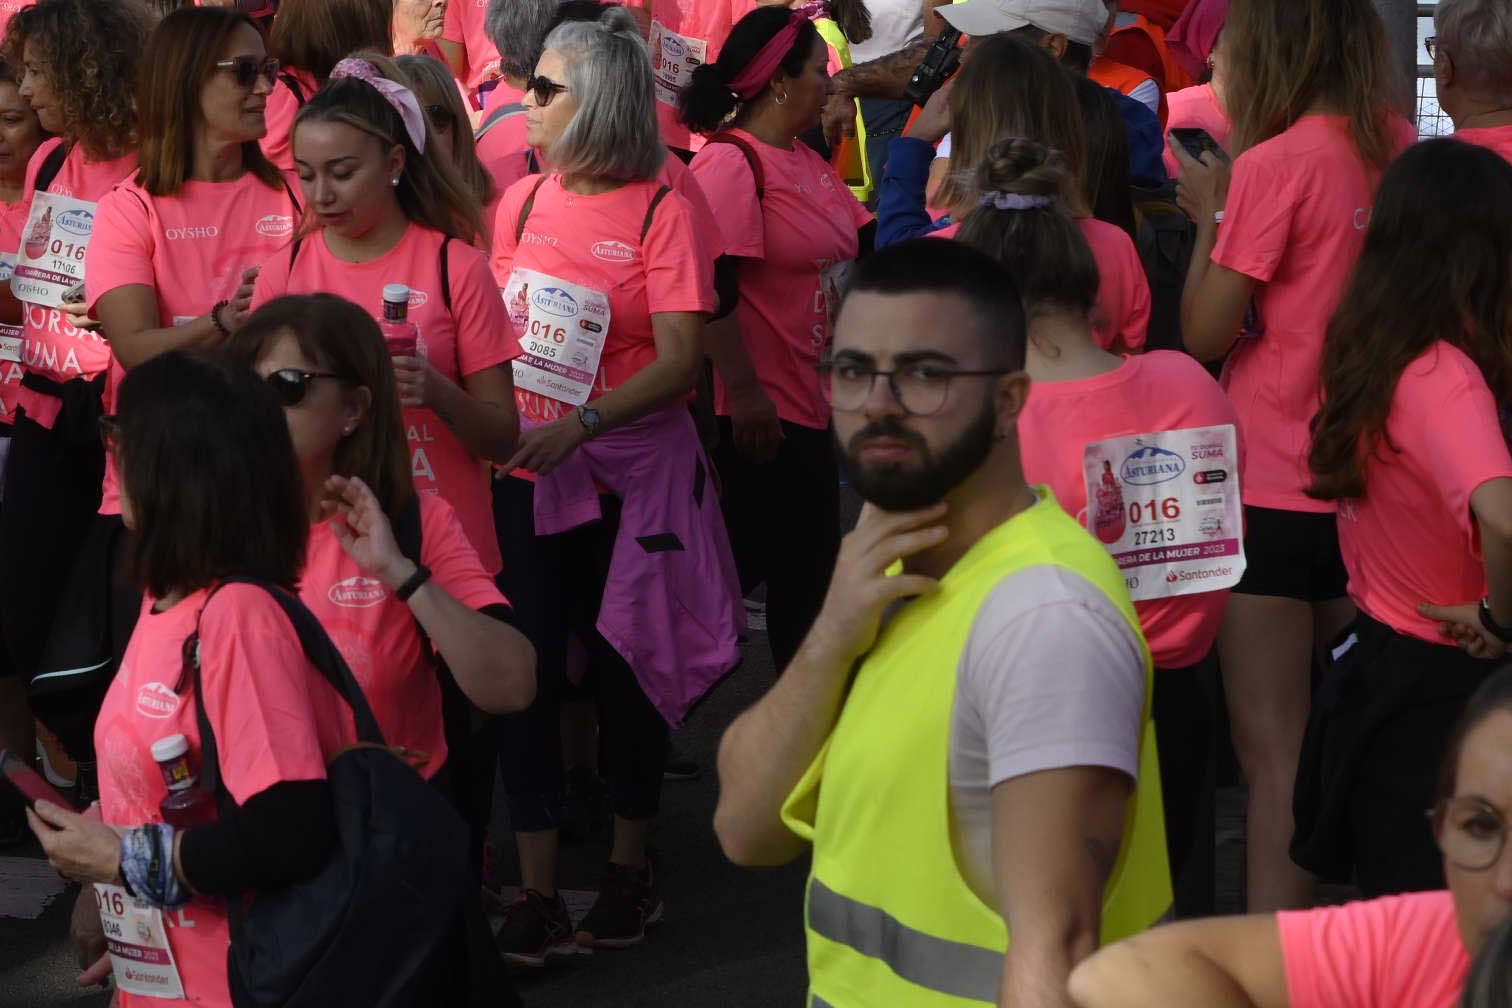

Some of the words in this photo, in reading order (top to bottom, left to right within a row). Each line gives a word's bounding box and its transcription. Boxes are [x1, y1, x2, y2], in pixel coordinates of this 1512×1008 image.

[662, 57, 681, 74] 016
[166, 225, 218, 241] OYSHO
[259, 223, 293, 233] ASTURIAN
[50, 238, 86, 261] 016
[593, 244, 635, 259] ASTURIANA
[530, 319, 567, 344] 016
[24, 340, 83, 374] UMA
[544, 361, 569, 375] MUJER
[1191, 449, 1224, 461] SUMA
[1124, 462, 1181, 480] ASTURIANA
[1128, 496, 1181, 525] 016
[1134, 527, 1176, 546] 27213
[1139, 552, 1151, 563] DE
[1152, 550, 1165, 561] LA
[1166, 546, 1201, 560] MUJER
[1178, 565, 1233, 583] Santander
[334, 586, 386, 603] ASTURIANA
